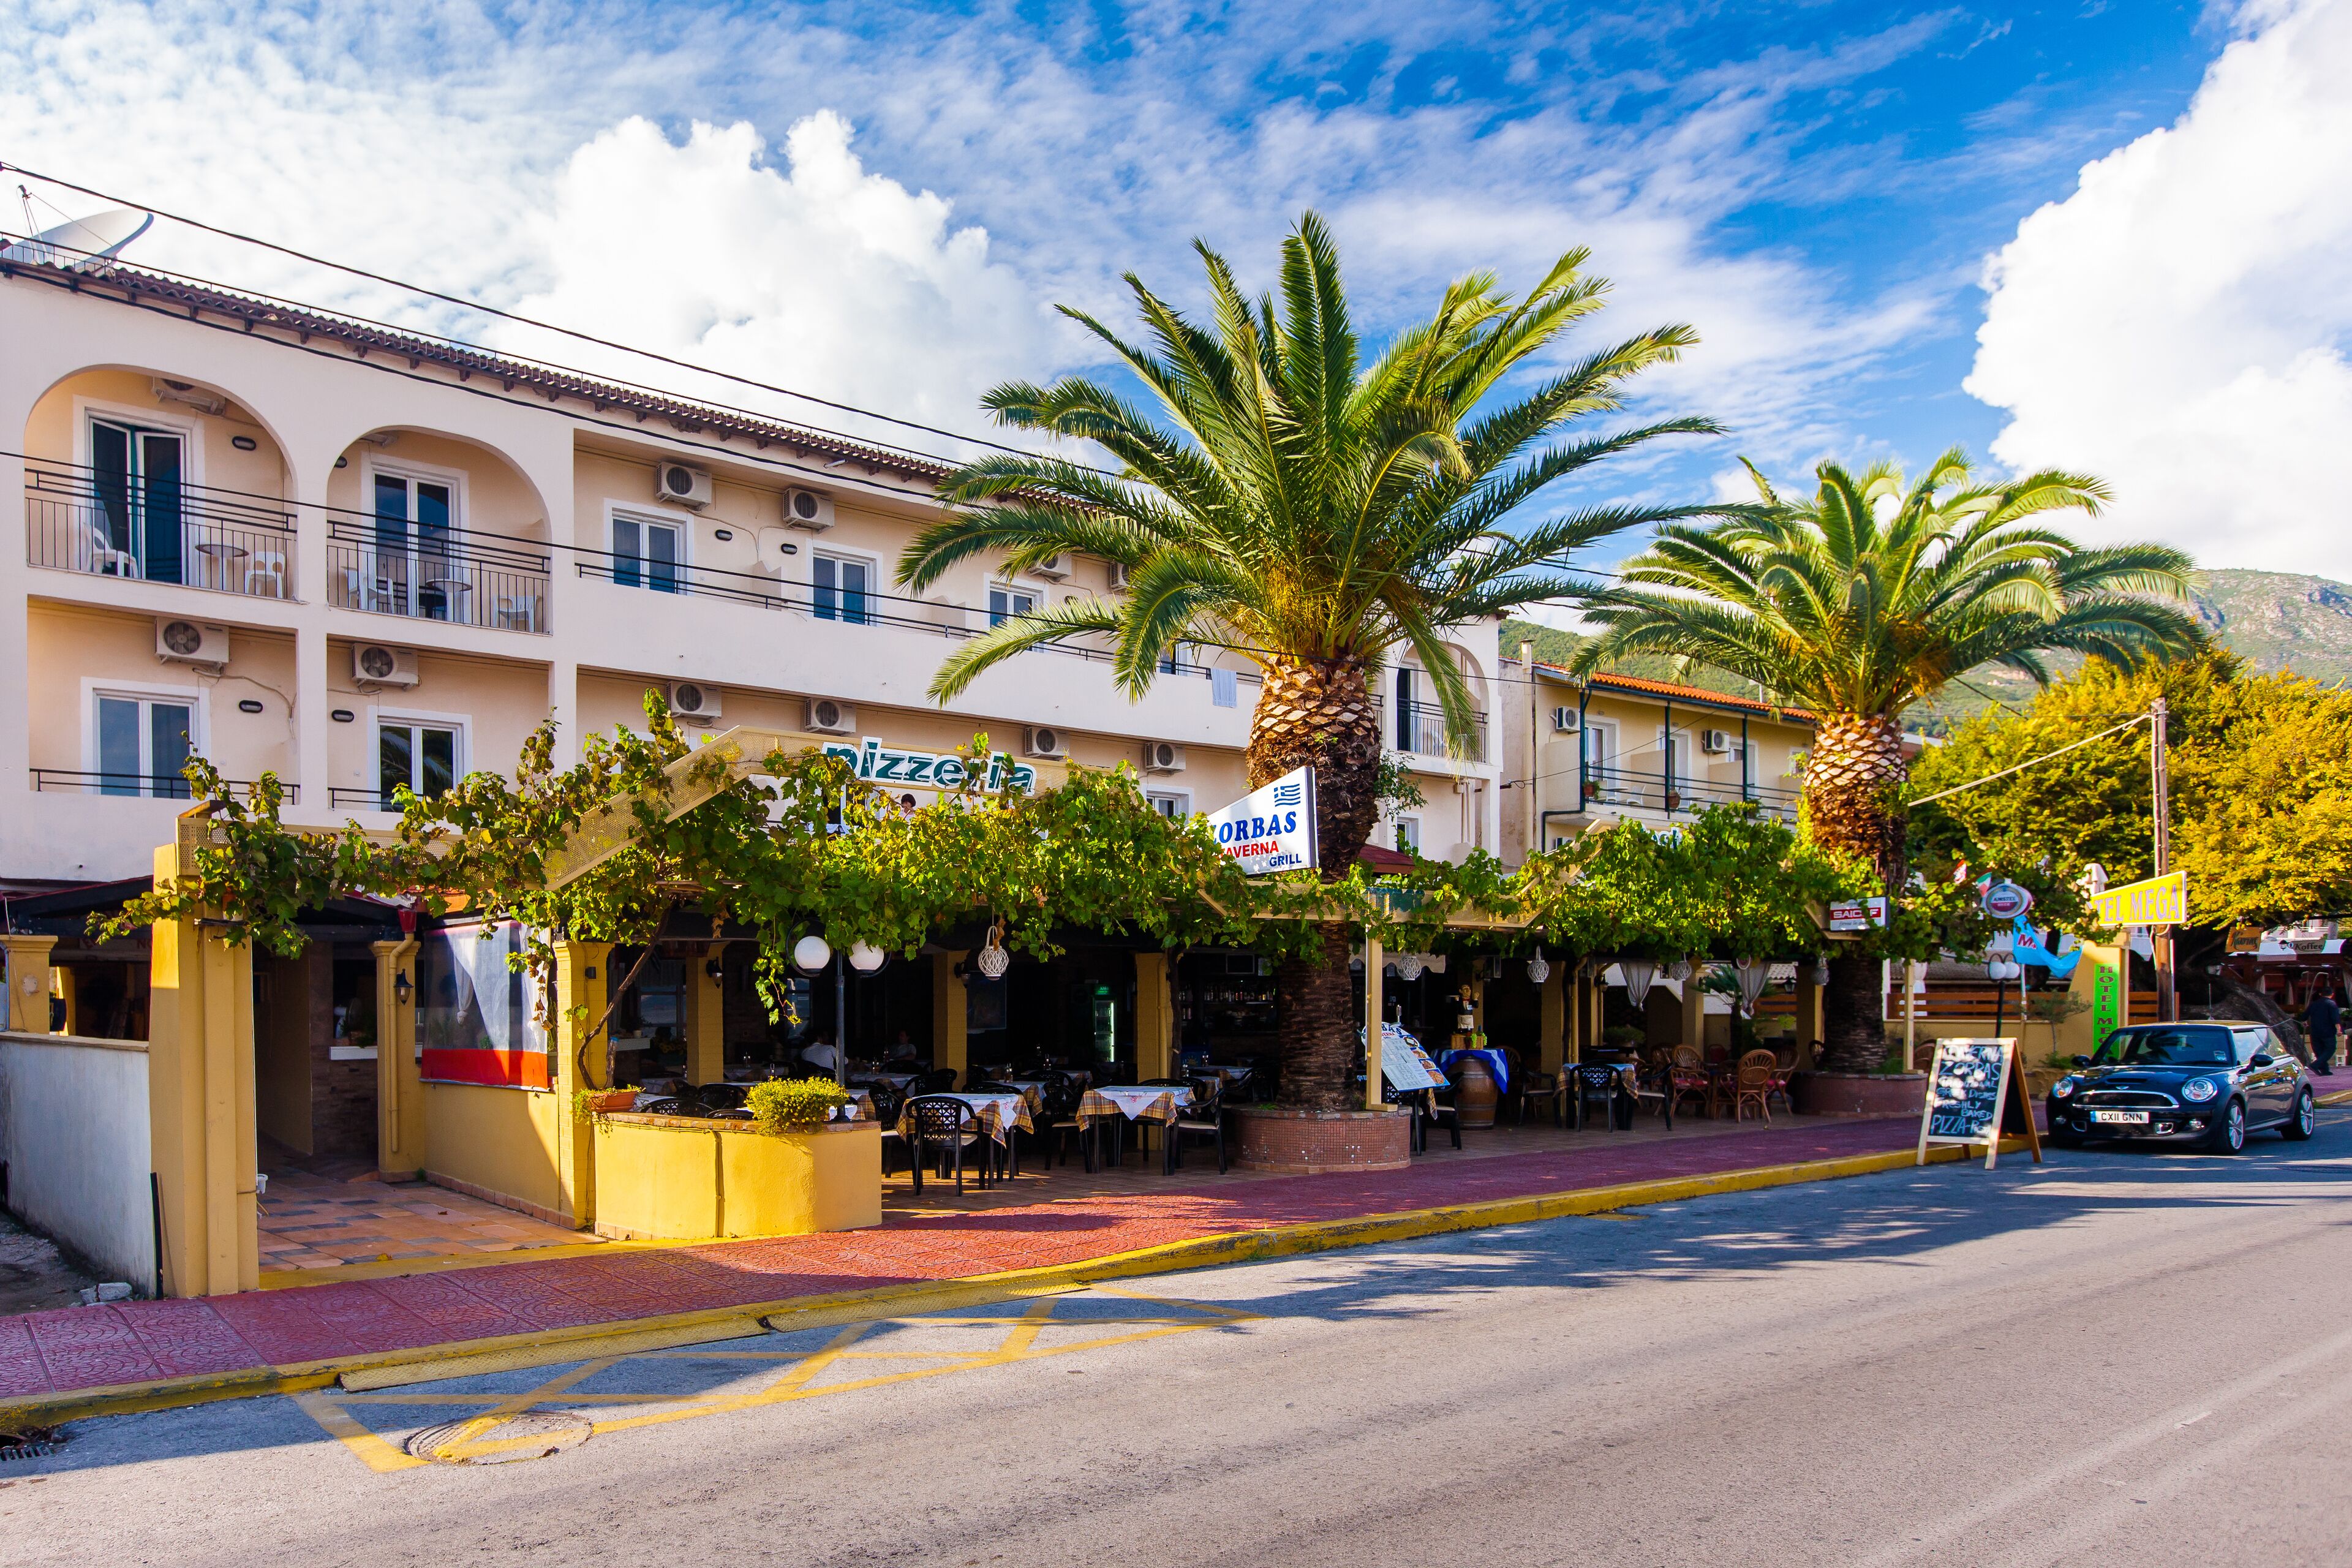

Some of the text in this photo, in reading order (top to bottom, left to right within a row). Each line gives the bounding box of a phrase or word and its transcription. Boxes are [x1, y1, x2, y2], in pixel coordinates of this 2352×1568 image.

[1213, 811, 1297, 845] ORBAS
[1269, 854, 1302, 867] GRILL
[2086, 884, 2180, 922] TEL MEGA
[1833, 909, 1880, 919] SAICF
[2295, 942, 2323, 951] Koffee
[2098, 966, 2114, 1012] HOTEL
[2122, 1113, 2143, 1121] GNN
